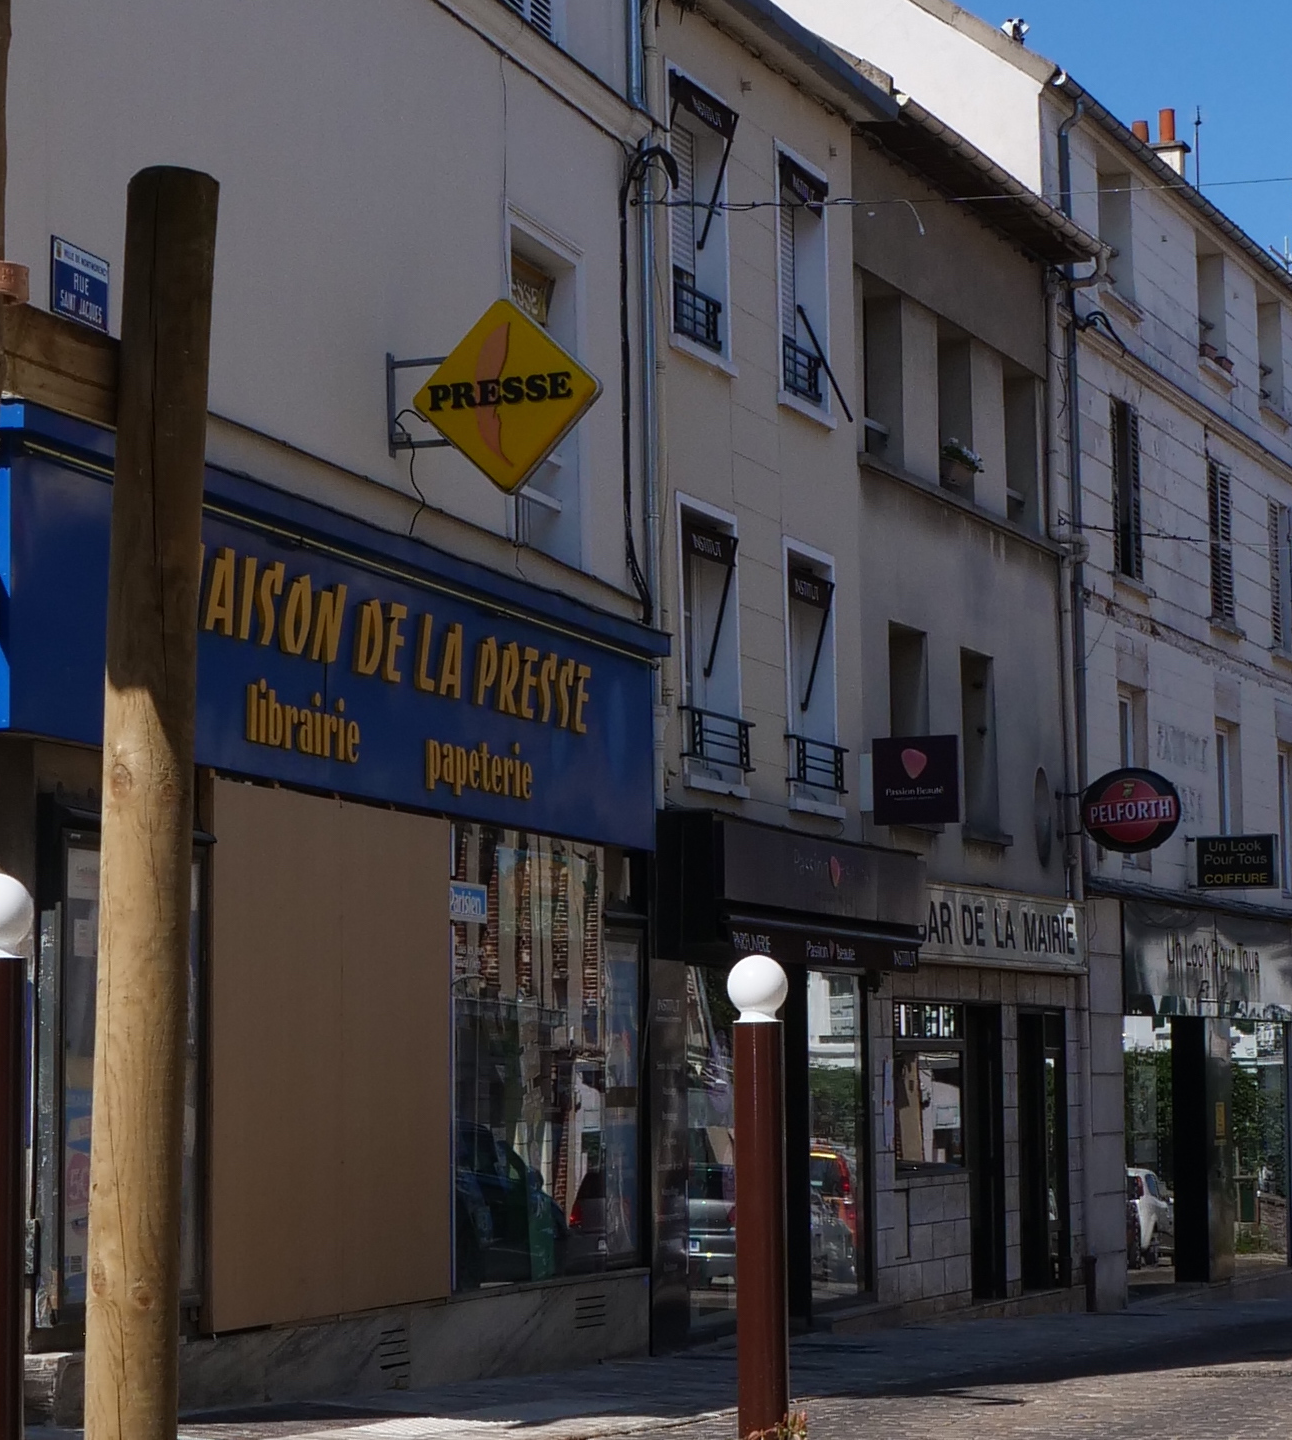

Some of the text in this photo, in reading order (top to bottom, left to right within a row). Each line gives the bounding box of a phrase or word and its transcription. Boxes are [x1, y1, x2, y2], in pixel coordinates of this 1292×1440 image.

[73, 272, 90, 296] RUE
[60, 289, 103, 324] SAINT JACQUES
[428, 371, 574, 411] PRESSE
[200, 543, 591, 734] AISON DE LA PRESSE
[246, 677, 361, 764] librairie
[425, 741, 533, 800] papeterie
[885, 787, 916, 797] Passion
[1090, 798, 1172, 824] PELFORTH
[1203, 853, 1268, 866] Pour Tous
[1208, 840, 1262, 853] Un Look
[1204, 872, 1269, 884] COIFFURE
[961, 904, 986, 947] DE
[994, 908, 1016, 950] LA
[1022, 912, 1076, 955] MAIRIE
[806, 940, 830, 959] Passion
[1167, 930, 1181, 966] Un
[1184, 935, 1210, 969] Look
[1211, 939, 1235, 971] Pour
